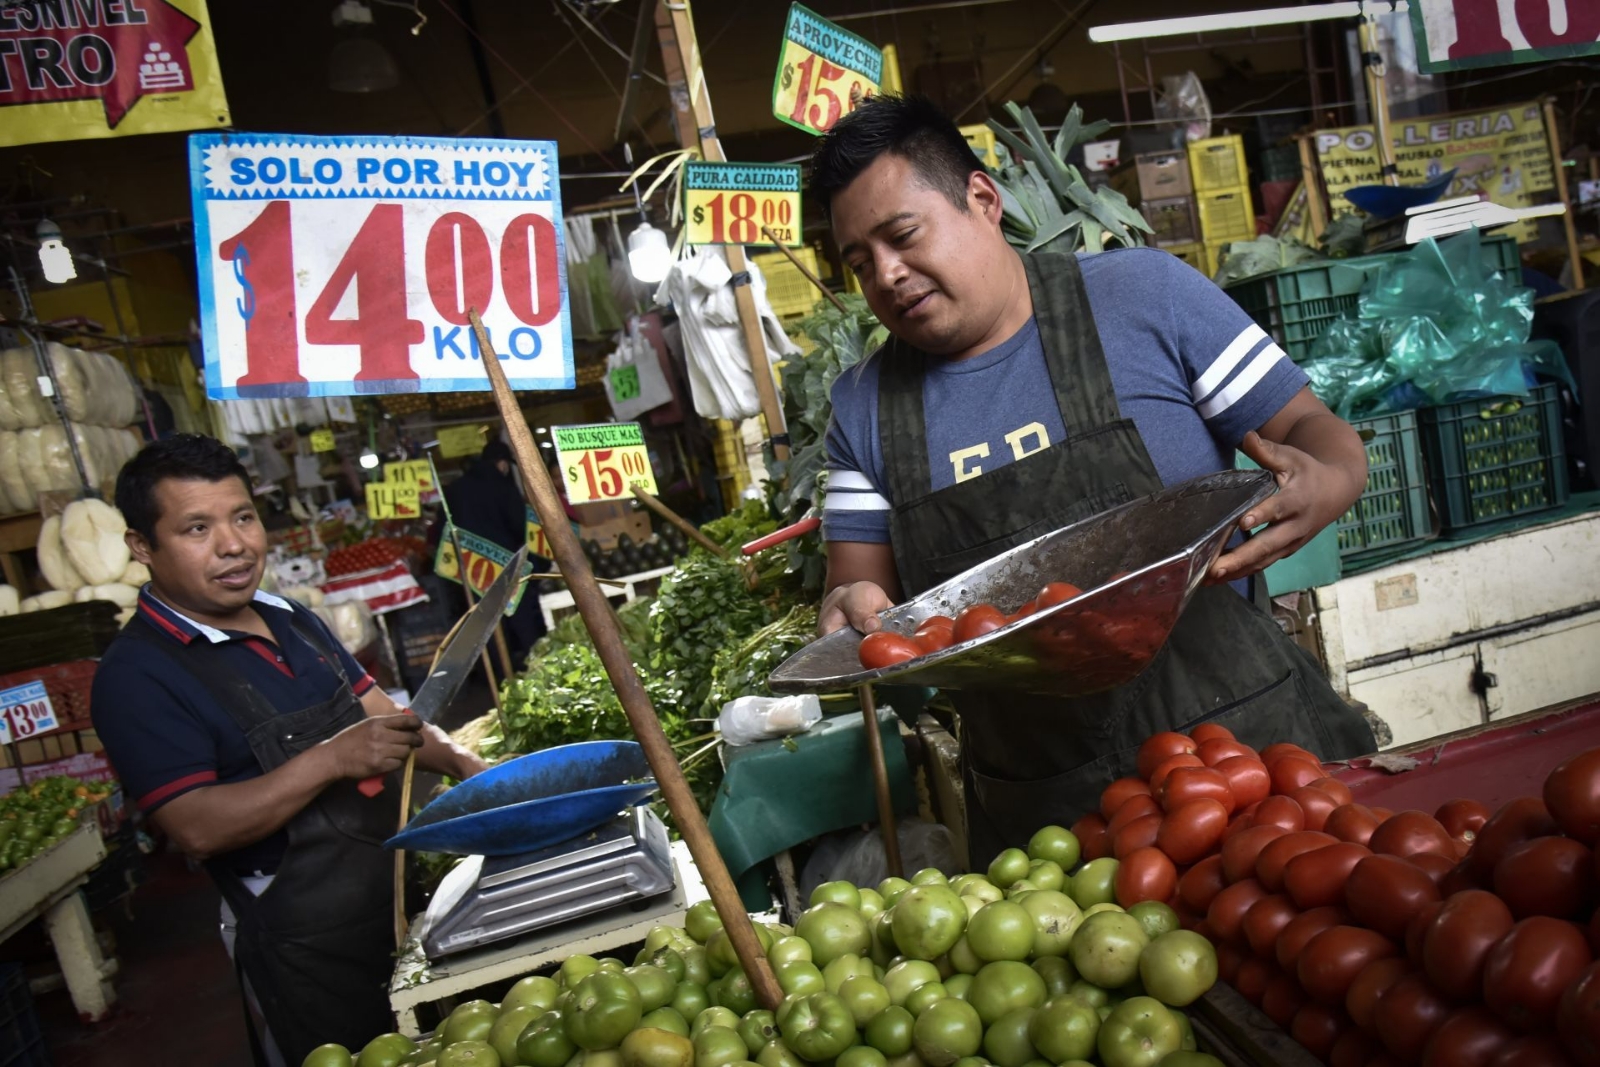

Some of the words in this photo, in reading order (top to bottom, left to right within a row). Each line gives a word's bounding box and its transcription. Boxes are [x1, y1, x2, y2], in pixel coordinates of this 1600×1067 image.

[789, 18, 879, 75] APROVECHE
[1317, 112, 1515, 154] POLERIA
[230, 157, 342, 185] SOLO
[357, 158, 442, 184] POR
[454, 161, 535, 186] HOY
[692, 171, 729, 184] PURA
[734, 172, 795, 186] CALIDAD
[761, 227, 793, 242] PEZA
[560, 432, 575, 445] NO
[577, 430, 618, 444] BUSQUE
[620, 428, 640, 441] MAS
